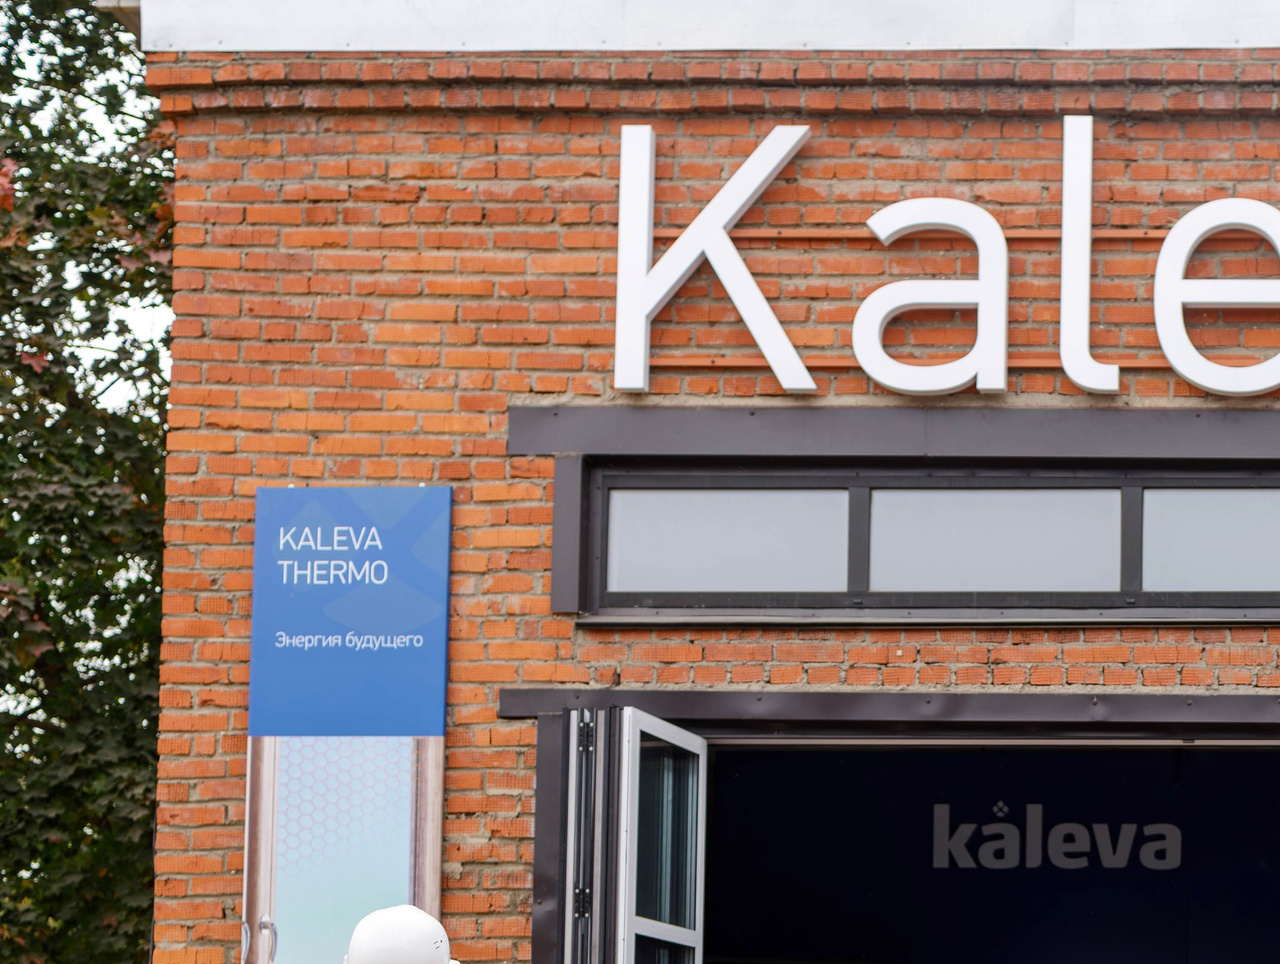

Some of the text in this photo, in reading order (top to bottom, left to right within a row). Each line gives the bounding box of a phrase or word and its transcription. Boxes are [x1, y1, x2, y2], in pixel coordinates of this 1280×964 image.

[279, 526, 383, 551] KALEVA
[277, 560, 388, 585] THERMO
[275, 631, 424, 651] Энергия будущего
